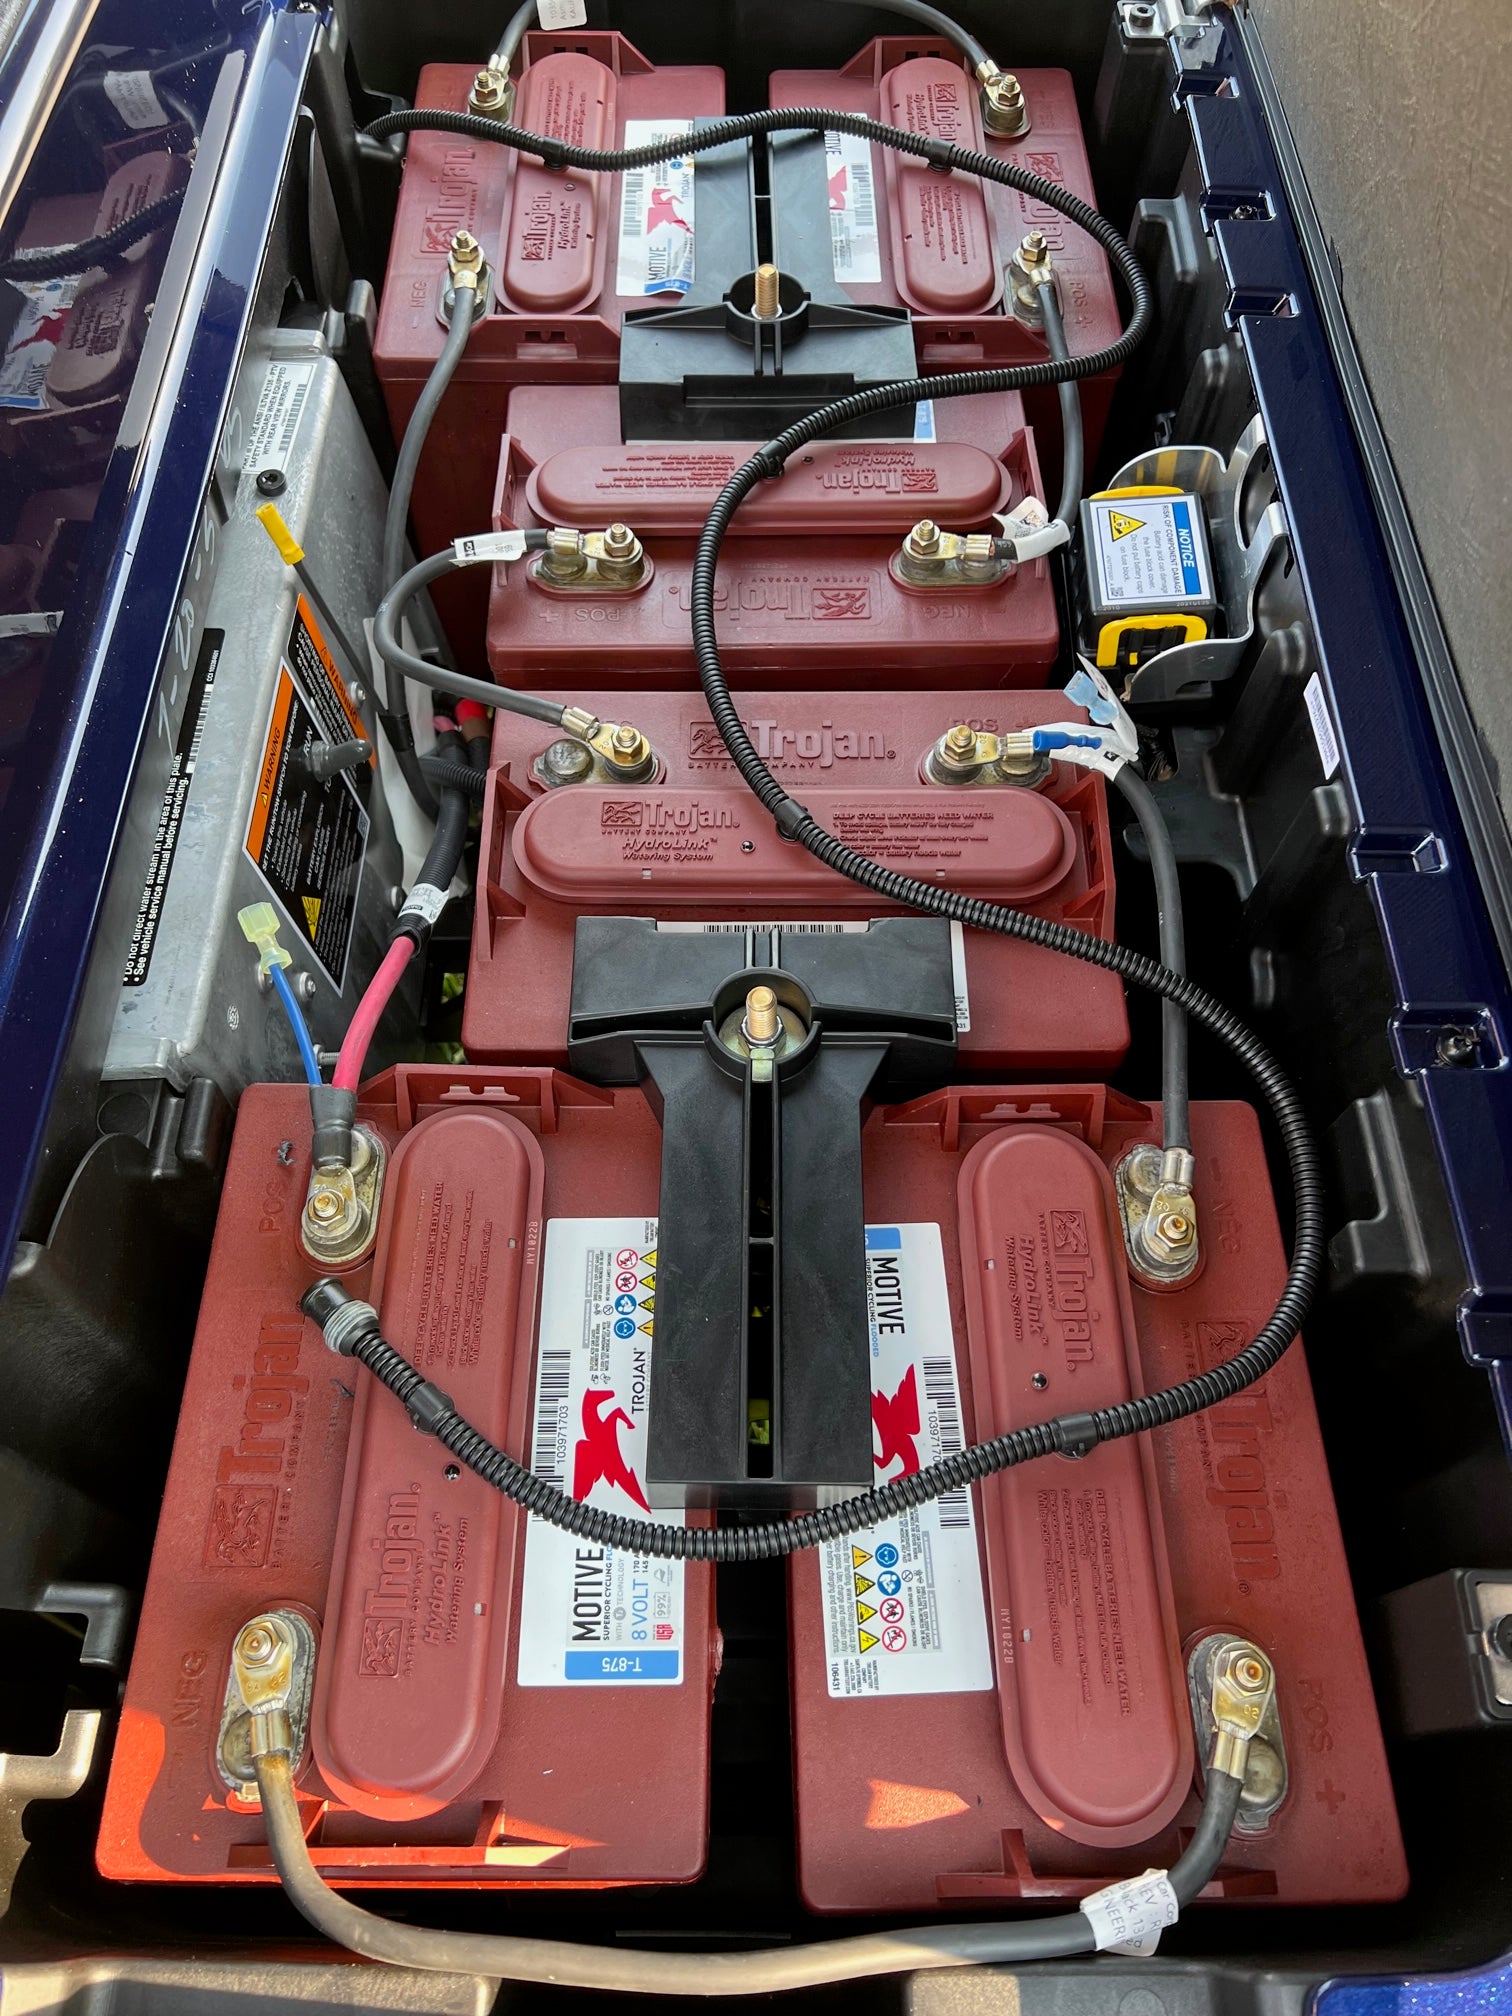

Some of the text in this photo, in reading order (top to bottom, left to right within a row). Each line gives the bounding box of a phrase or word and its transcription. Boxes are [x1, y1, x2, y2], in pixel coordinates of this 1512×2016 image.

[932, 104, 962, 142] Trojan
[424, 150, 479, 226] Trojan
[522, 192, 554, 240] Trojan
[680, 173, 691, 200] TROJAN
[647, 246, 668, 282] MOTIVE
[249, 366, 286, 468] SAFETY STANDARD WHEN EQUIPPED
[262, 408, 282, 455] WITH REAR VIEW
[822, 470, 901, 494] Trojan
[1162, 505, 1182, 593] RISK OF COMPONENT DAMAGE
[1178, 528, 1195, 568] NOTICE
[262, 724, 281, 793] WARNING
[302, 723, 313, 758] RUN
[752, 720, 885, 768] Trojan
[622, 838, 711, 852] HydroLink
[645, 800, 733, 834] Trojan
[623, 852, 714, 862] Watering System
[1037, 1212, 1055, 1307] BATTERY COMPANY
[1209, 1200, 1242, 1254] NEG
[414, 1181, 444, 1364] DEEP CYCLE BATTERIES NEED WATER
[872, 1256, 905, 1335] MOTIVE
[1004, 1235, 1024, 1340] Watering System
[1018, 1234, 1045, 1335] HydroLink
[867, 1291, 880, 1358] CYCLING FLOODED
[1052, 1257, 1101, 1360] Trojan
[215, 1311, 303, 1484] Trojan
[630, 1351, 646, 1416] TROJAN
[556, 1405, 569, 1466] 103971703
[927, 1409, 942, 1464] 10397170
[1206, 1386, 1288, 1582] Trojan
[271, 1486, 292, 1570] BATTERY
[362, 1492, 425, 1616] Trojan
[423, 1523, 451, 1645] HydroLink
[446, 1517, 470, 1645] Watering System
[571, 1547, 604, 1642] MOTIVE
[614, 1557, 626, 1641] WITH TECHNOLOGY
[632, 1559, 641, 1575] 170
[642, 1559, 650, 1575] 145
[824, 1550, 838, 1621] battery charging and other
[1036, 1490, 1063, 1667] White color battery needs water
[404, 1551, 425, 1678] BATTERY COMPANY
[602, 1561, 613, 1641] SUPERIOR CYCLING
[631, 1578, 650, 1641] 8 VOLT
[655, 1623, 675, 1641] USA
[656, 1593, 669, 1617] 99%
[835, 1584, 848, 1652] charge and maintain only
[1094, 1490, 1131, 1718] DEEP CYCLE BATTERIES NEED WATER
[171, 1650, 207, 1728] NEG
[601, 1656, 644, 1672] T-875
[831, 1662, 842, 1692] 106431
[1297, 1679, 1335, 1753] POS
[1118, 1882, 1140, 1914] Black
[1156, 1881, 1171, 1899] Car
